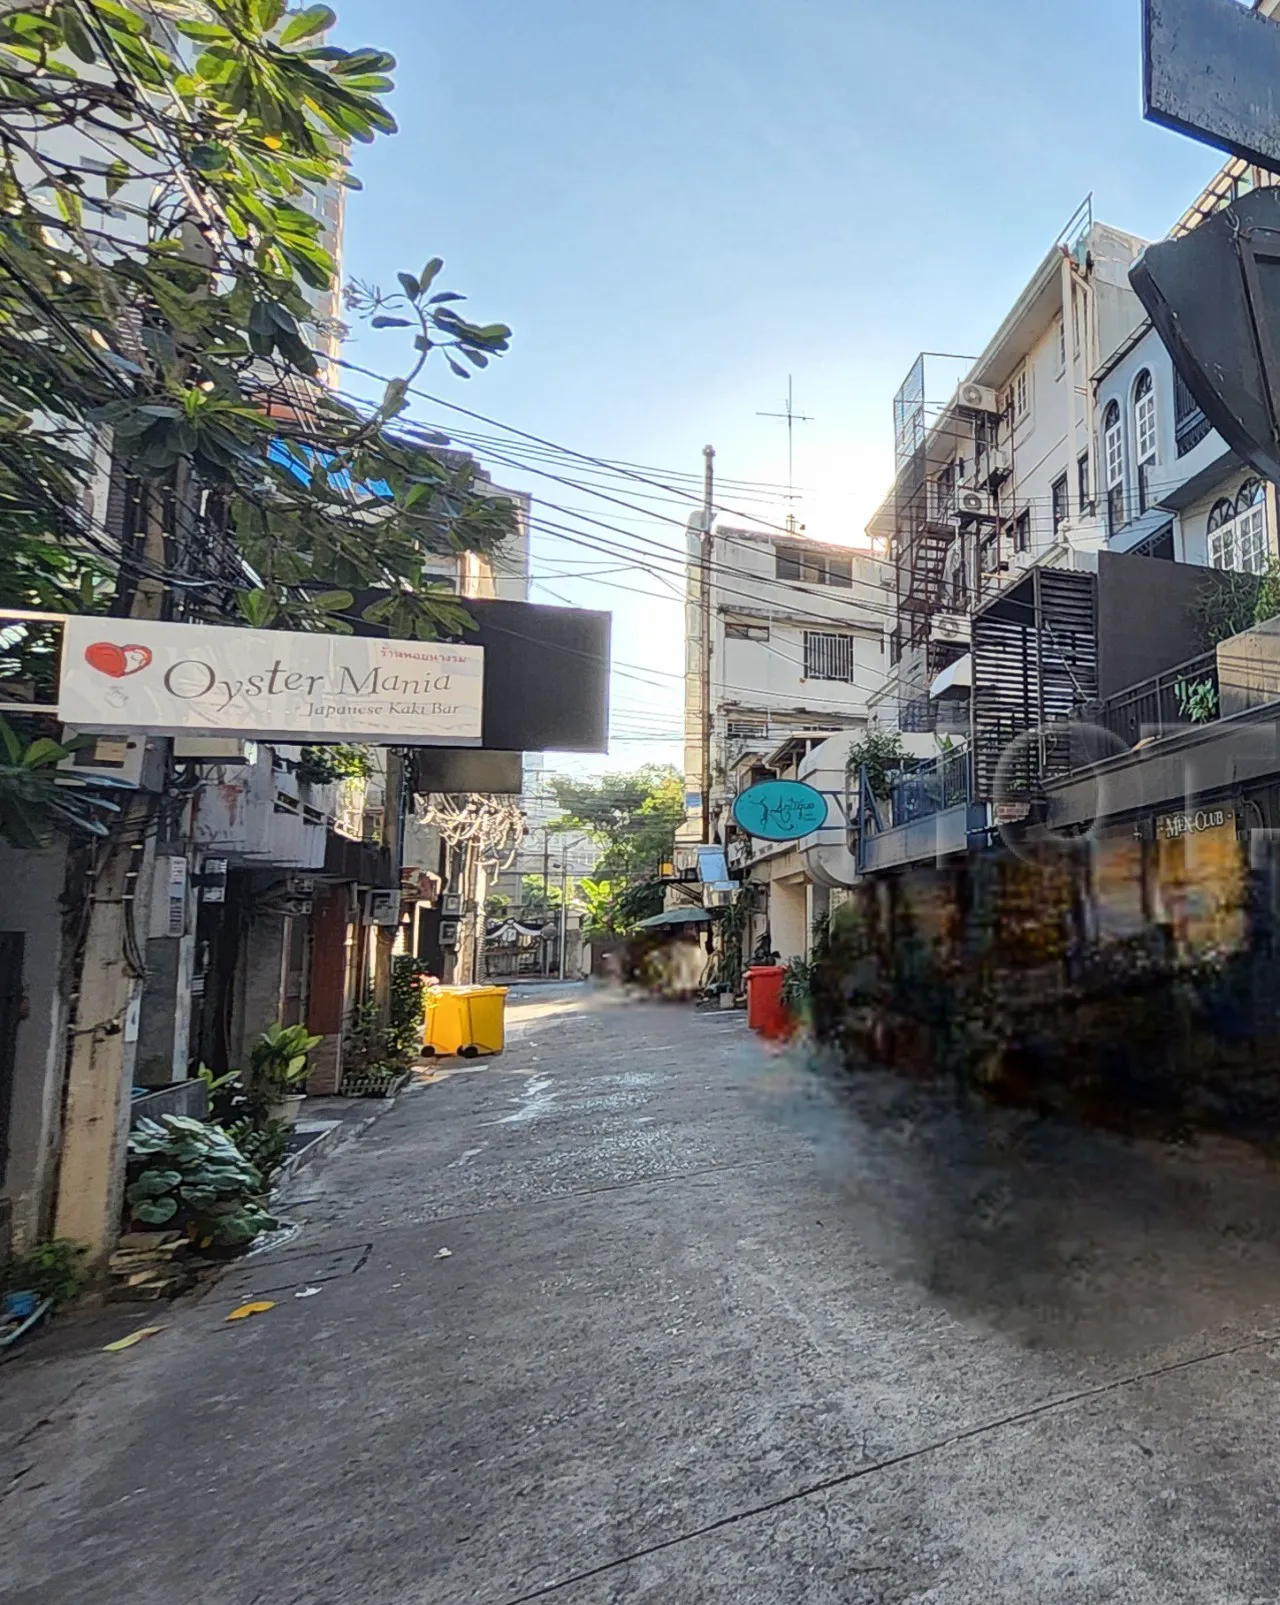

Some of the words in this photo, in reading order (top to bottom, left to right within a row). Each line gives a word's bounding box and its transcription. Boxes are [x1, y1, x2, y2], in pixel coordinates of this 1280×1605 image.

[163, 659, 325, 713] Oyster
[336, 665, 452, 696] Mania
[307, 702, 384, 718] Japanese
[388, 701, 426, 715] Kaki
[430, 701, 460, 715] Bar
[1194, 810, 1225, 831] CLUB
